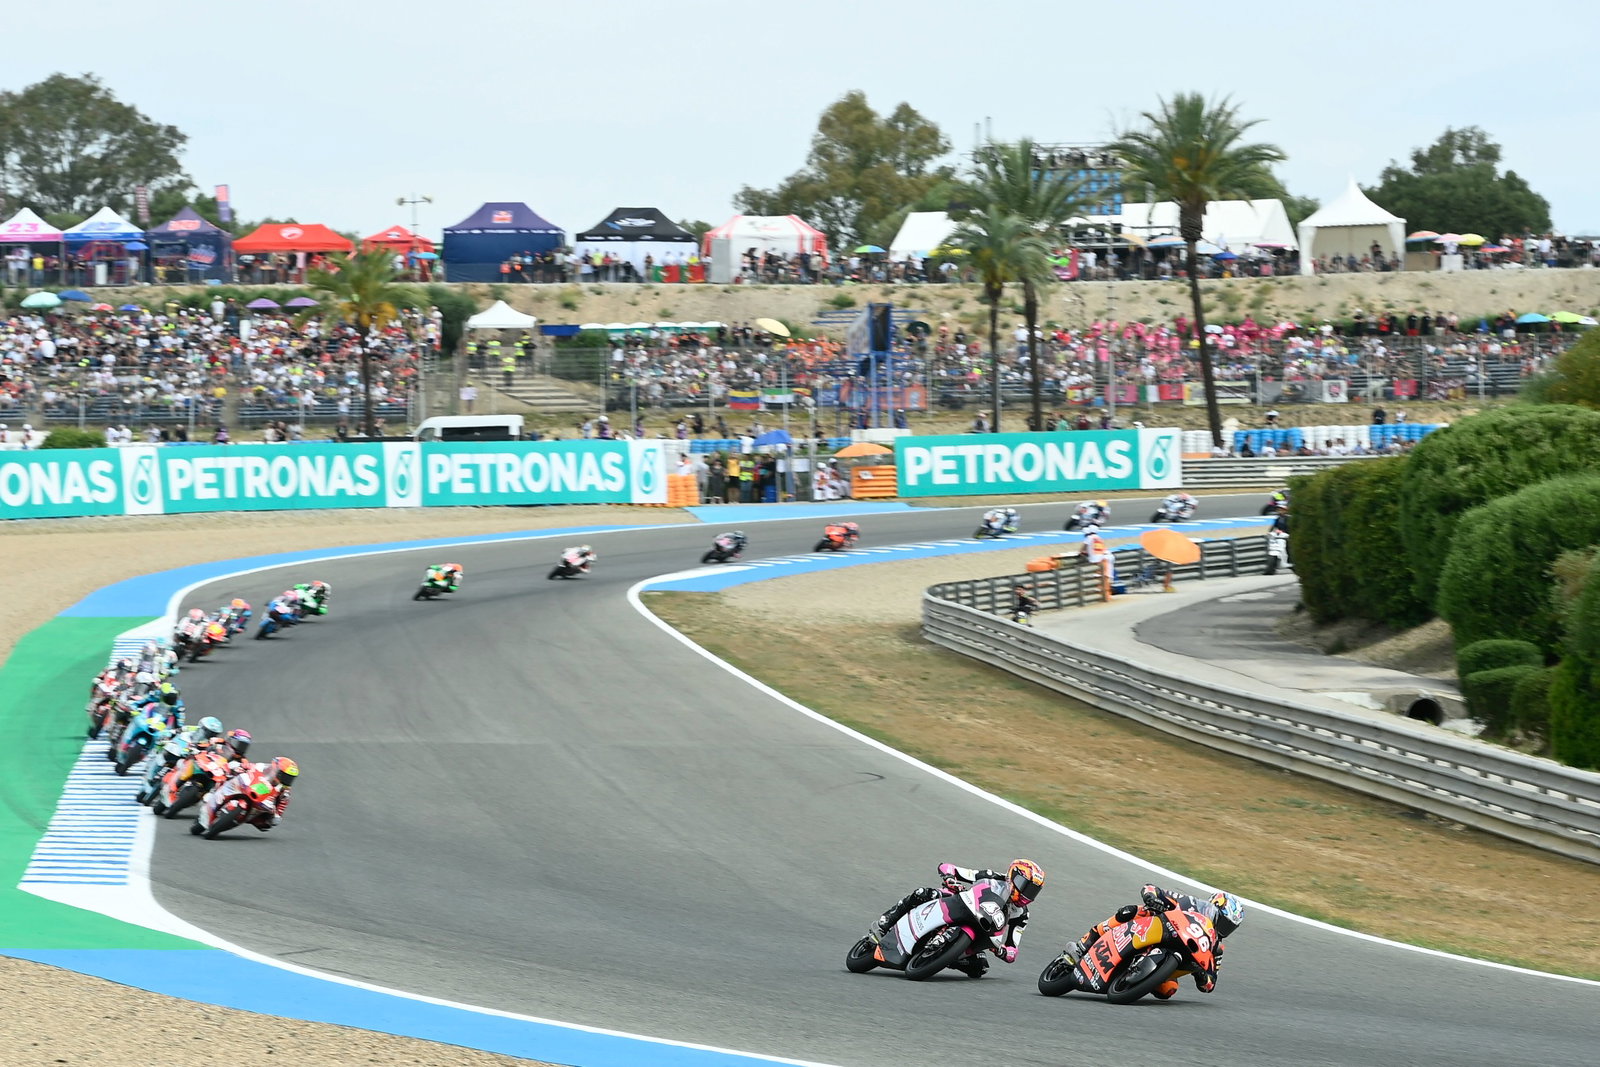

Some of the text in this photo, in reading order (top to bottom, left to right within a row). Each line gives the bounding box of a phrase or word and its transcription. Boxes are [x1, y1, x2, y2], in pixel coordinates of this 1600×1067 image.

[0, 460, 118, 507] ONAS
[167, 454, 379, 500] PETRONAS
[427, 452, 626, 494] PETRONAS
[903, 440, 1133, 485] PETRONAS
[979, 901, 1005, 930] 48
[1093, 940, 1115, 975] KTM
[1186, 923, 1210, 953] 96
